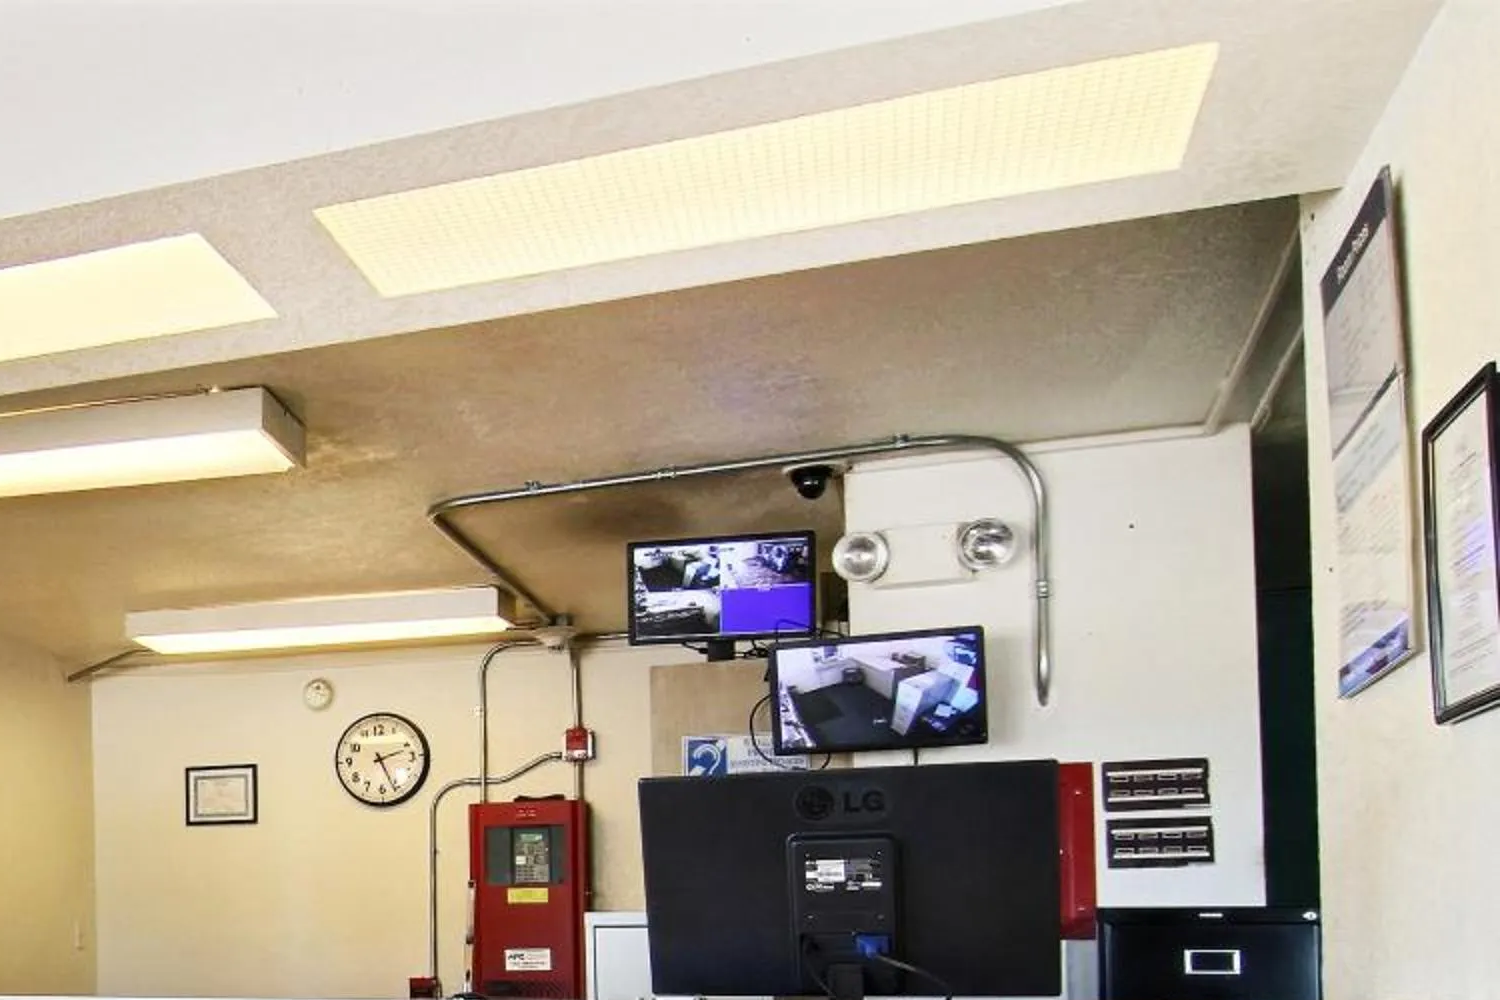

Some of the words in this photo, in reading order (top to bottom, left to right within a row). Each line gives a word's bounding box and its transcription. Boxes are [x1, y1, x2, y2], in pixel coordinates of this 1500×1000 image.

[372, 723, 385, 737] 12
[350, 743, 361, 753] 10
[345, 757, 353, 768] 9
[408, 751, 417, 763] 3
[363, 780, 371, 793] 7
[378, 783, 387, 795] 6
[843, 790, 885, 813] LG
